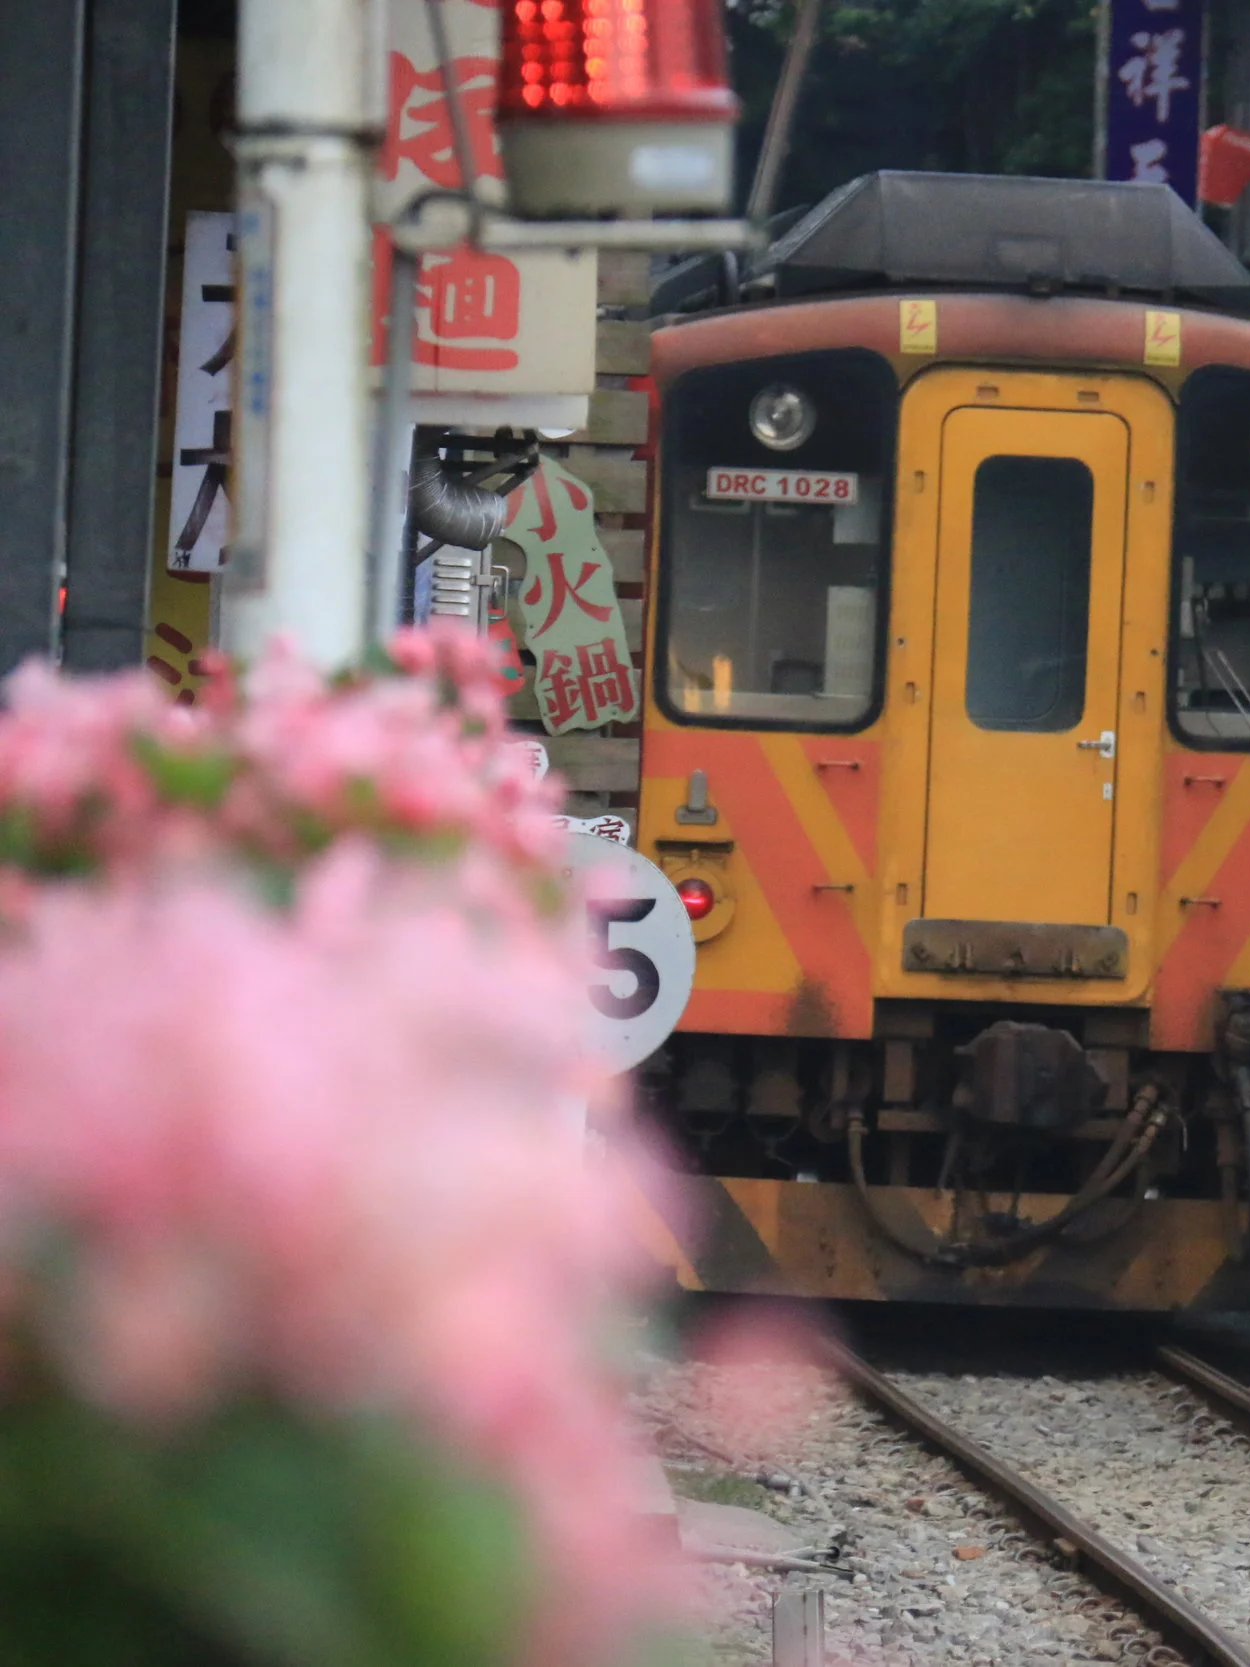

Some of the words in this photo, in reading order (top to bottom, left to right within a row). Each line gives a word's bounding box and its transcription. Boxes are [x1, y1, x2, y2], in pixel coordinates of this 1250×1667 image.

[716, 473, 767, 495] DRC
[777, 477, 850, 498] 1028
[504, 462, 635, 729] 小火鍋
